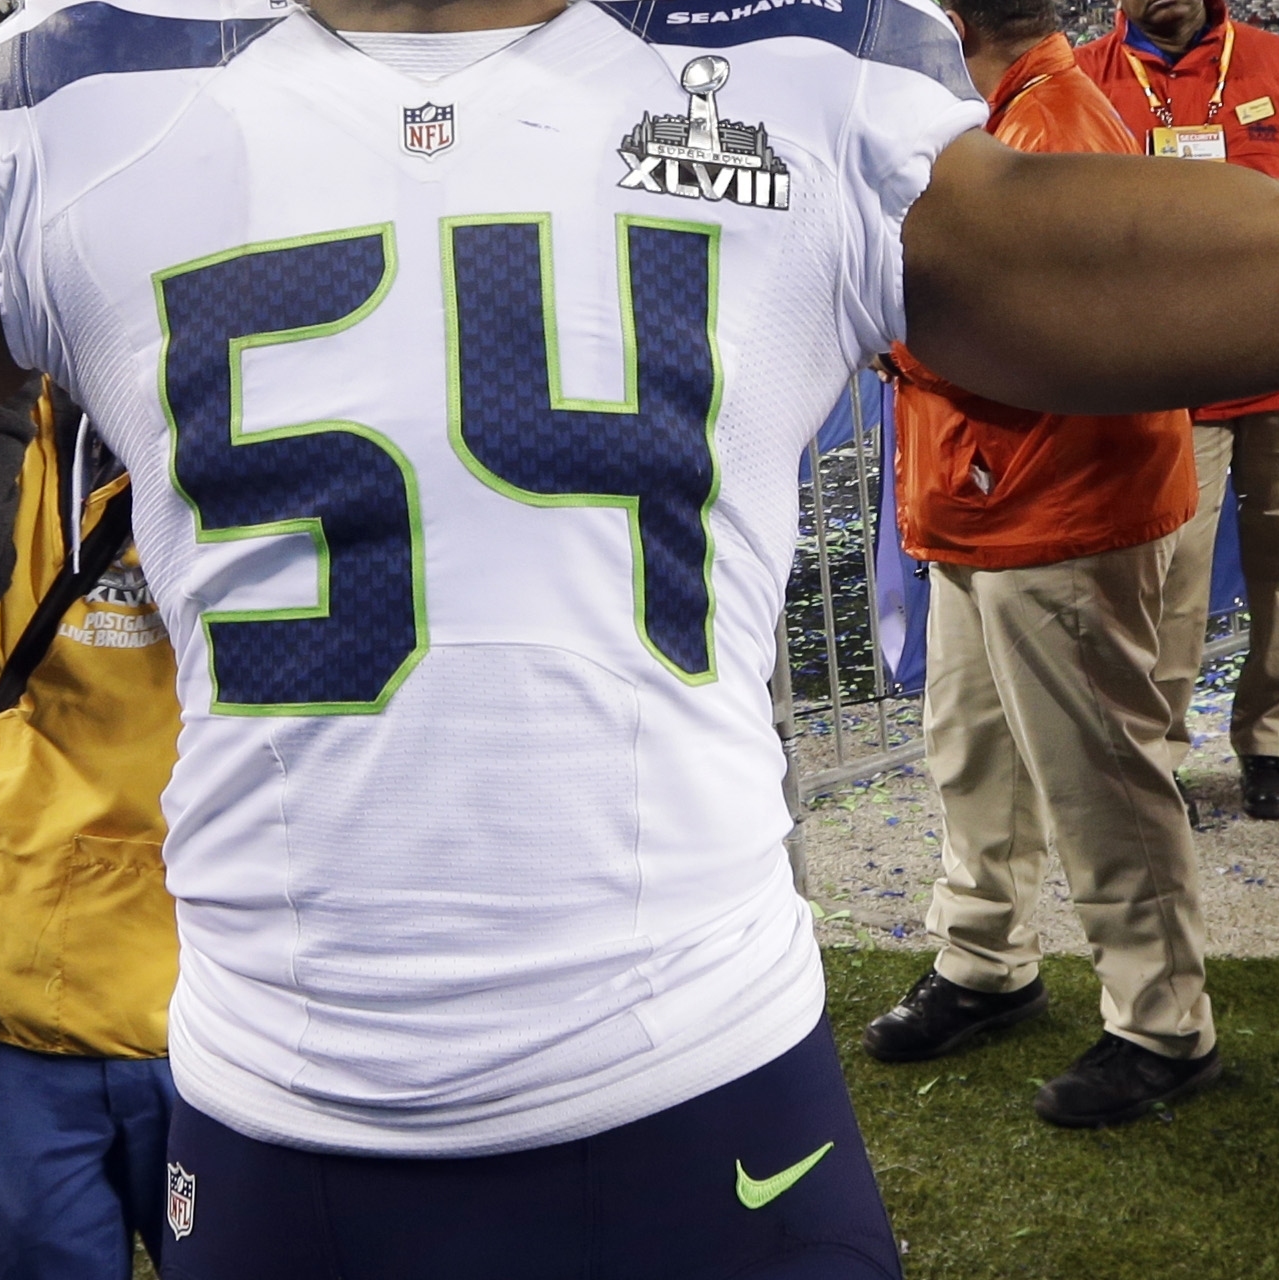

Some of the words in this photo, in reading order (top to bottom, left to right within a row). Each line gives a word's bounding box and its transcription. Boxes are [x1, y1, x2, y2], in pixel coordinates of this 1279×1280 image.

[408, 122, 451, 151] NFL
[1179, 132, 1220, 142] SECURITY
[656, 145, 707, 161] SUPER
[711, 153, 754, 167] BOWL
[616, 148, 791, 211] XLVIII
[150, 210, 725, 716] 54
[58, 623, 95, 646] LIVE
[83, 611, 157, 632] POSTGA
[170, 1194, 190, 1228] NFL
